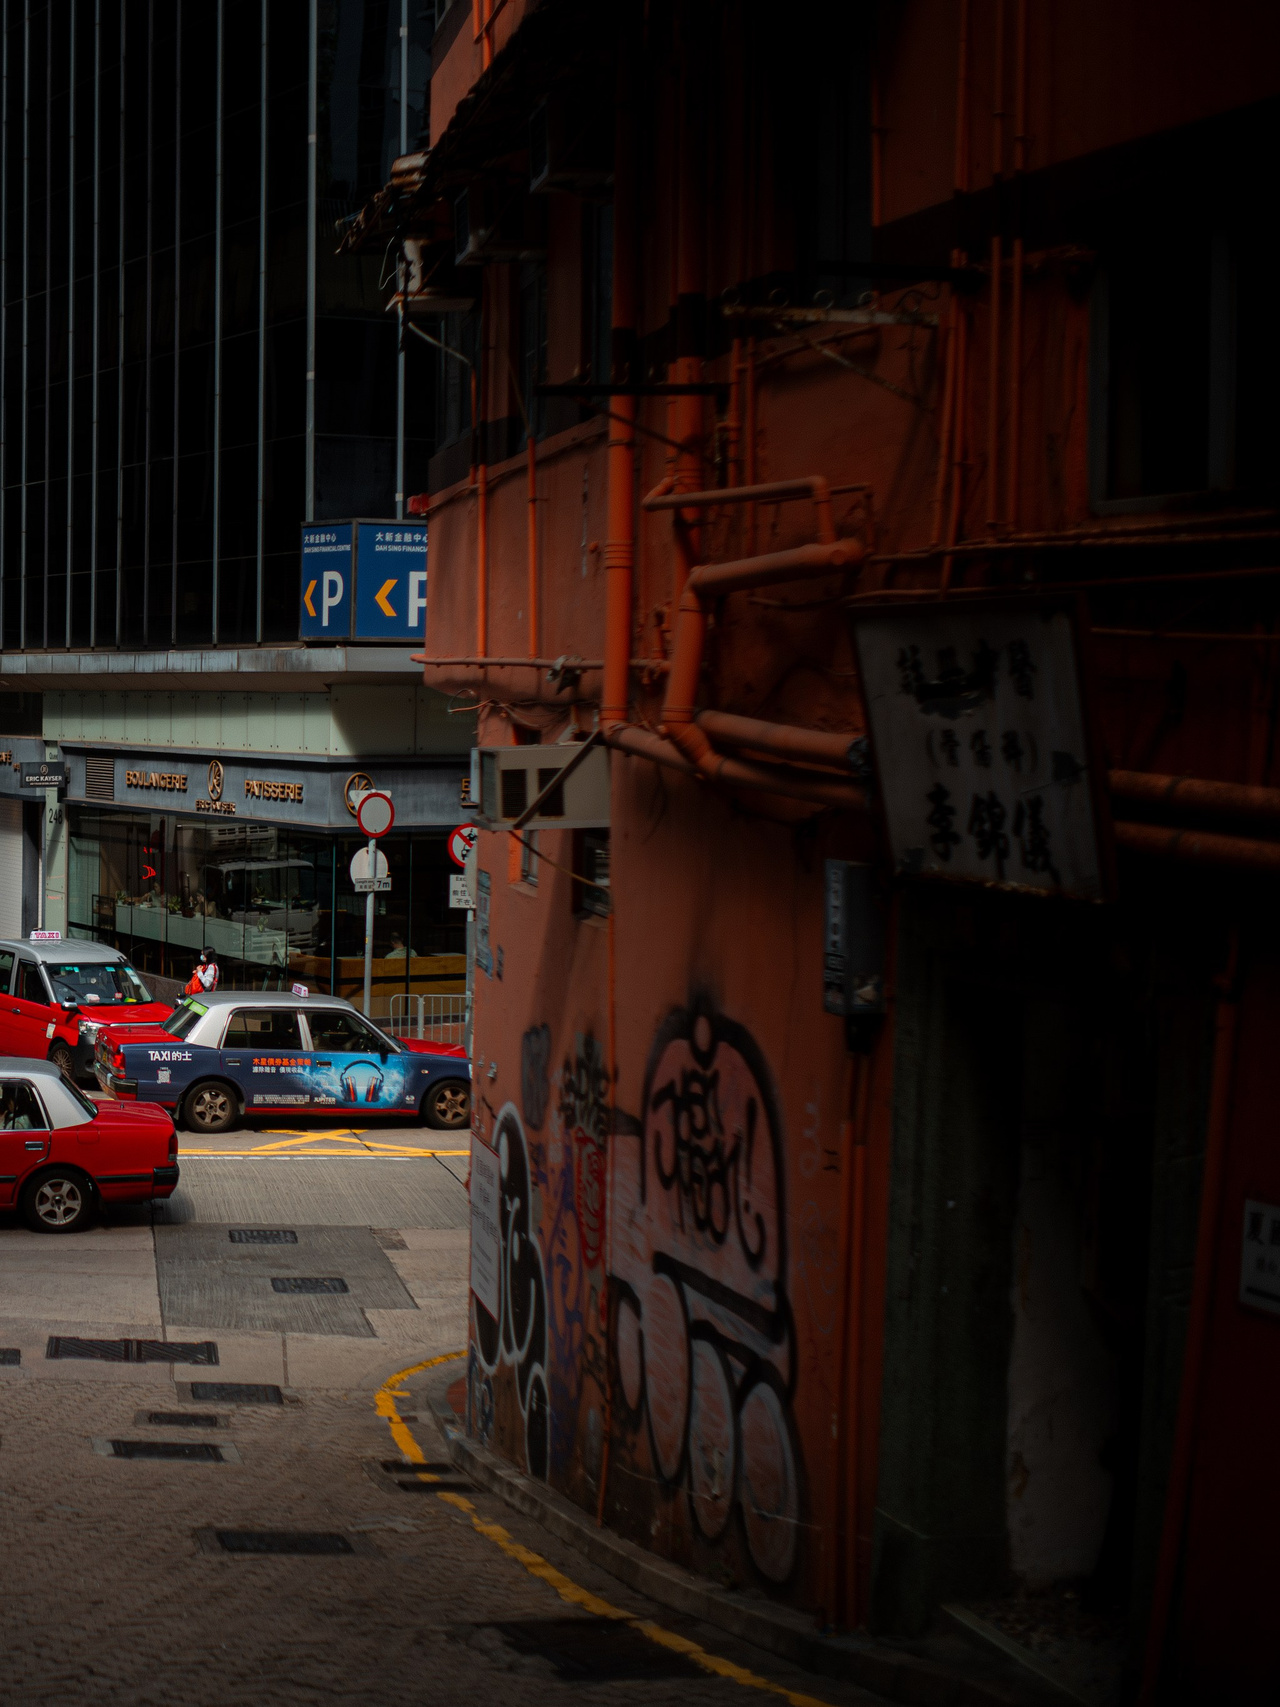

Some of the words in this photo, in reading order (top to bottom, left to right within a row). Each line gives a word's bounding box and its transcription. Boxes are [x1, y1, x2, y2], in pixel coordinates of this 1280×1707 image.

[322, 571, 343, 626] P
[125, 770, 188, 790] BOULANGERIE
[245, 780, 303, 800] PATISSERIE
[49, 808, 63, 824] 248
[148, 1050, 171, 1061] TAXI
[171, 1050, 192, 1061] 的士
